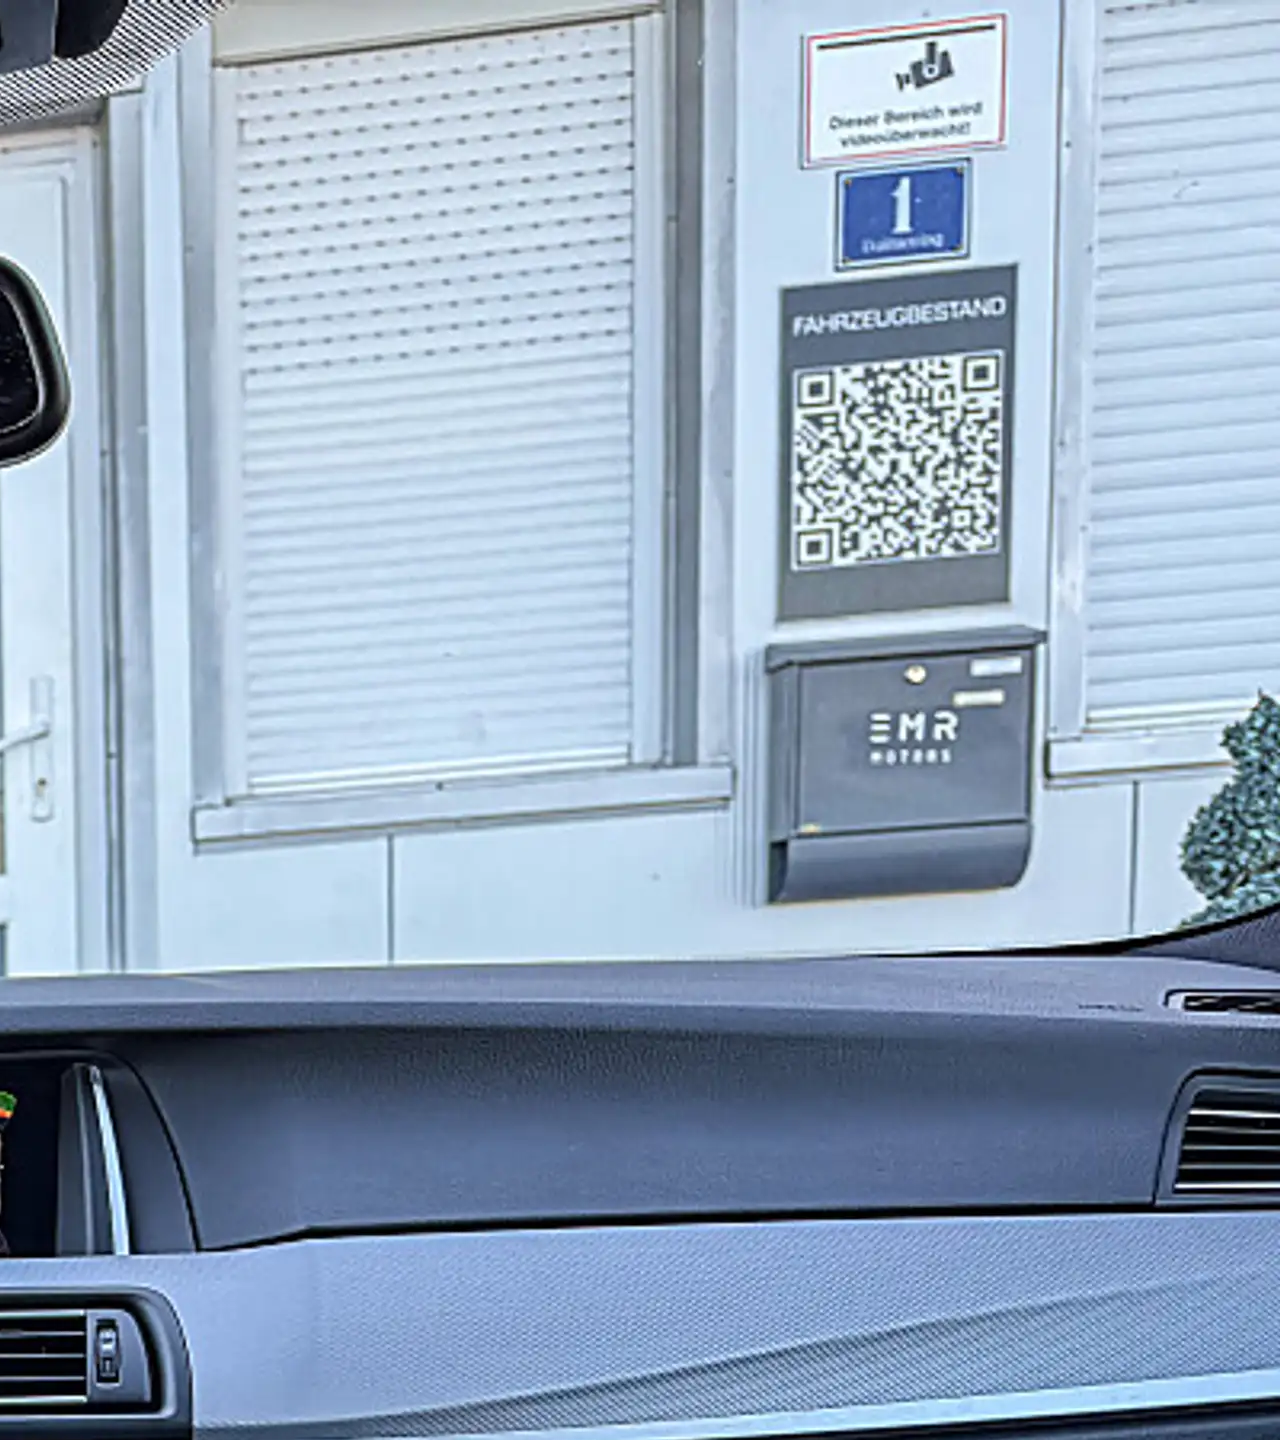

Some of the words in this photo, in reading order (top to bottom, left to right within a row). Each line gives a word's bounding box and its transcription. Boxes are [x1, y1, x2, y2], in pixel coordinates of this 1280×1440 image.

[829, 115, 880, 131] Dieser
[883, 105, 945, 126] Bereich
[947, 101, 983, 119] wird
[890, 176, 914, 235] 1
[792, 295, 1008, 338] FAHRZEUGBESTAND
[867, 710, 959, 744] EMR
